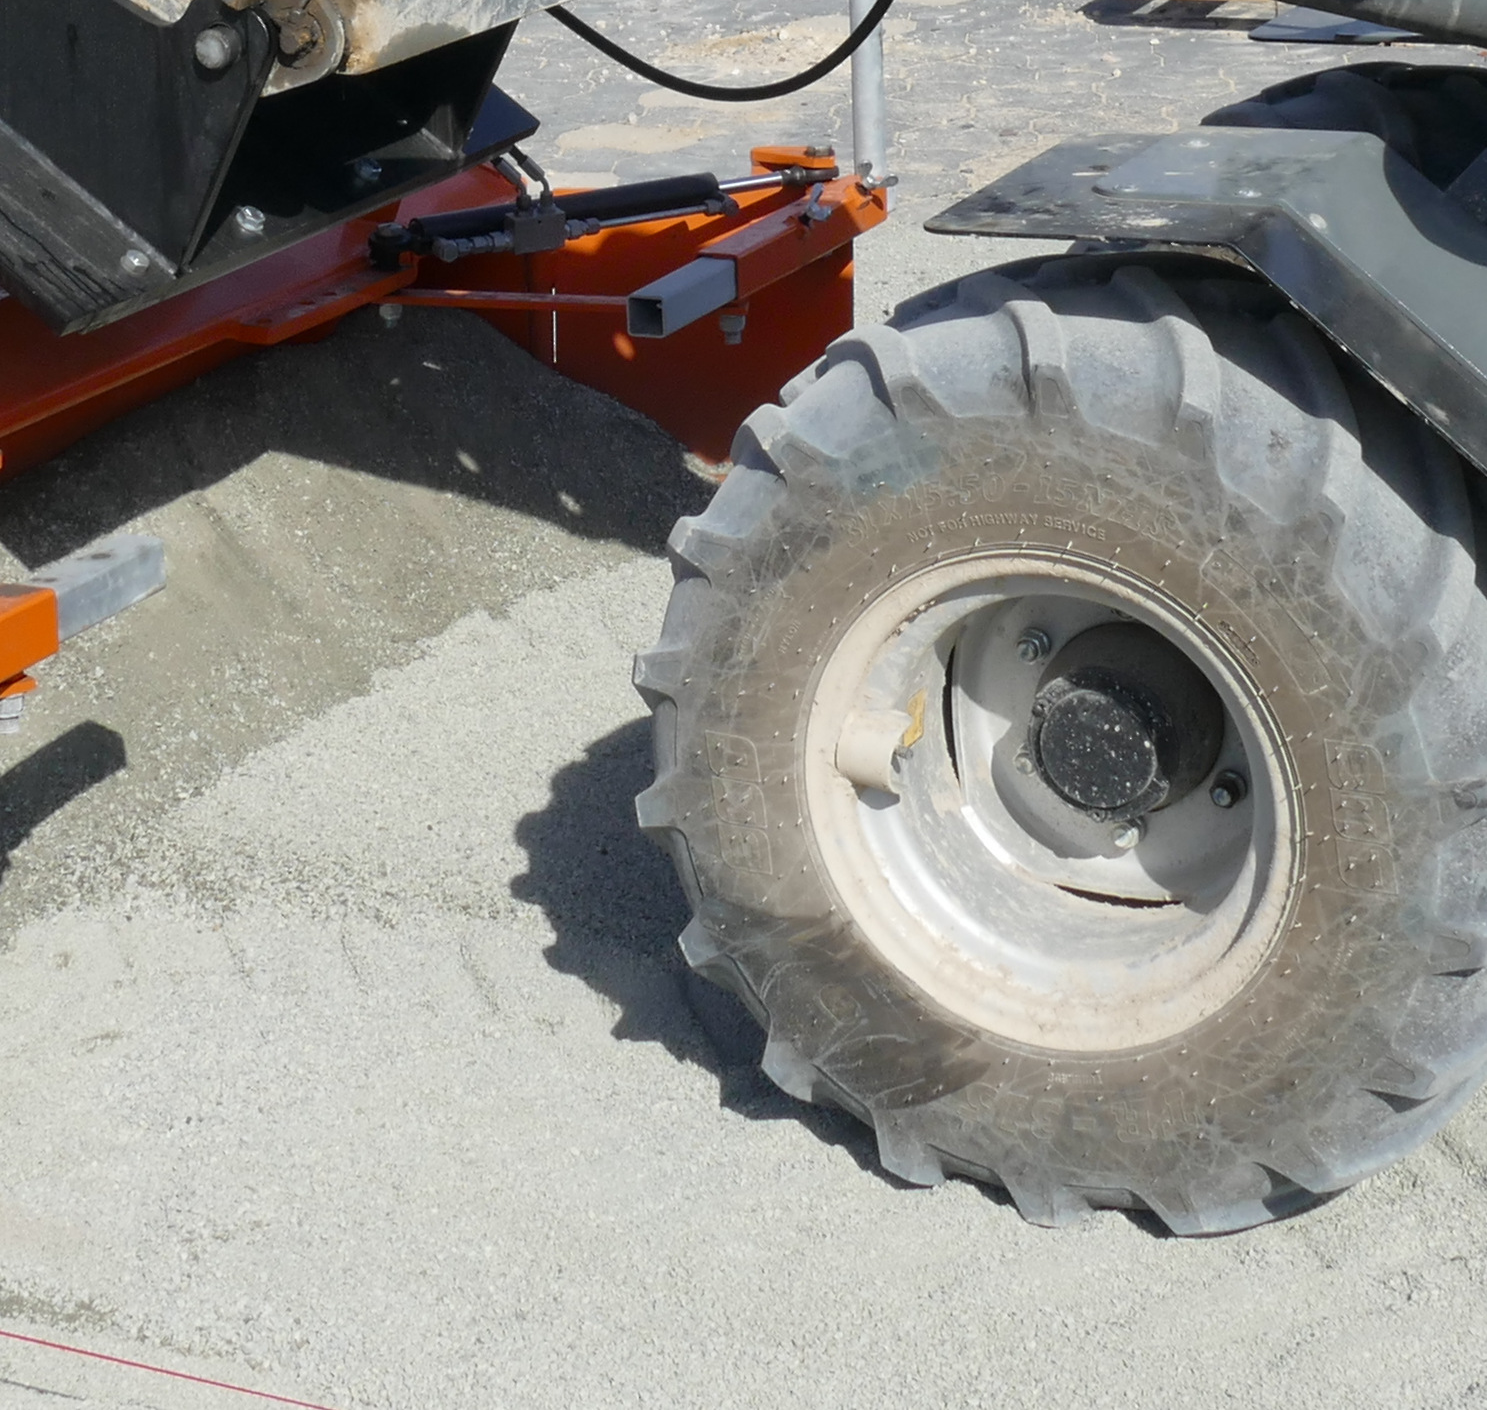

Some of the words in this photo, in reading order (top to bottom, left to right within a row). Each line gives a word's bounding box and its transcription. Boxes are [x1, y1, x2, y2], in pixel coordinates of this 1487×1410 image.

[906, 524, 935, 543] NOT
[937, 518, 968, 533] FOR
[969, 512, 1039, 527] HIGHWAY
[1043, 514, 1107, 541] SERVICE
